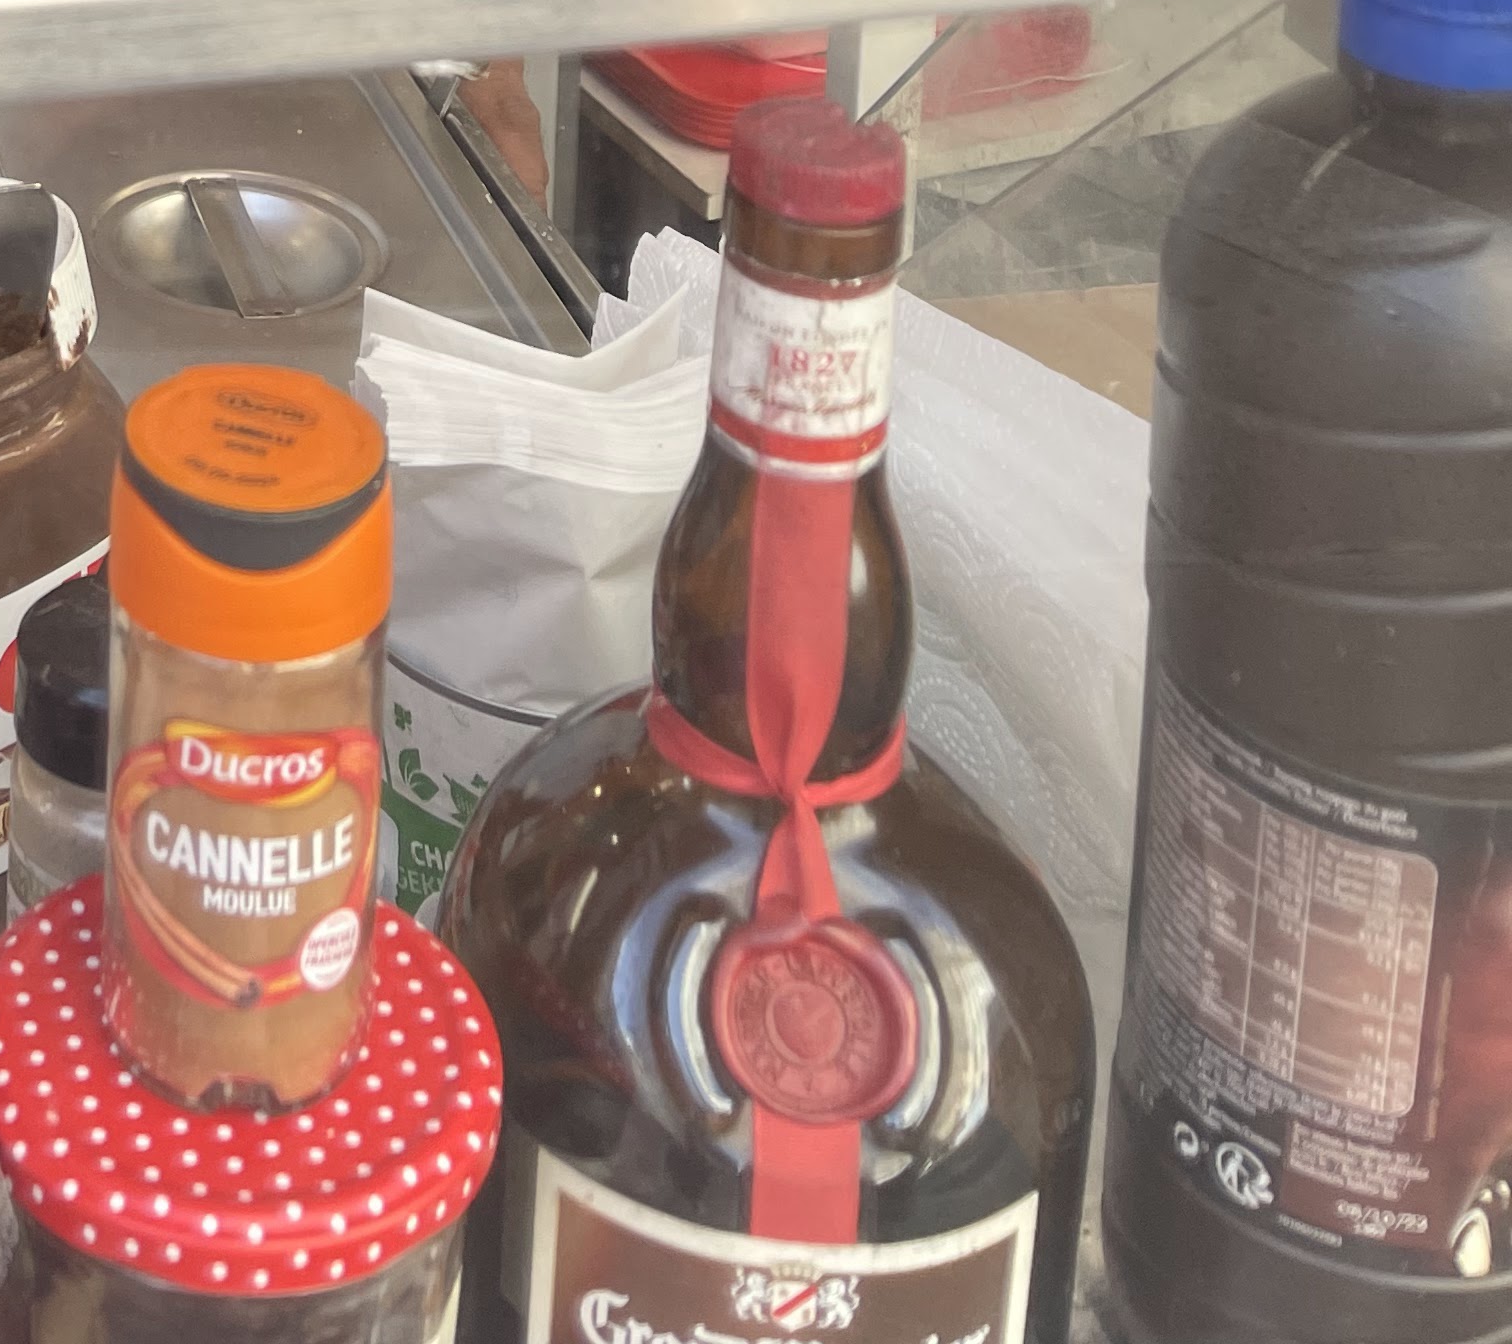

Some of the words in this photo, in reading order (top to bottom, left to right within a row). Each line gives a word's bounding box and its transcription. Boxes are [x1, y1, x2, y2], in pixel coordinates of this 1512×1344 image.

[179, 738, 327, 786] Ducros
[145, 811, 356, 888] CANNELLE
[203, 885, 296, 915] MOULUE
